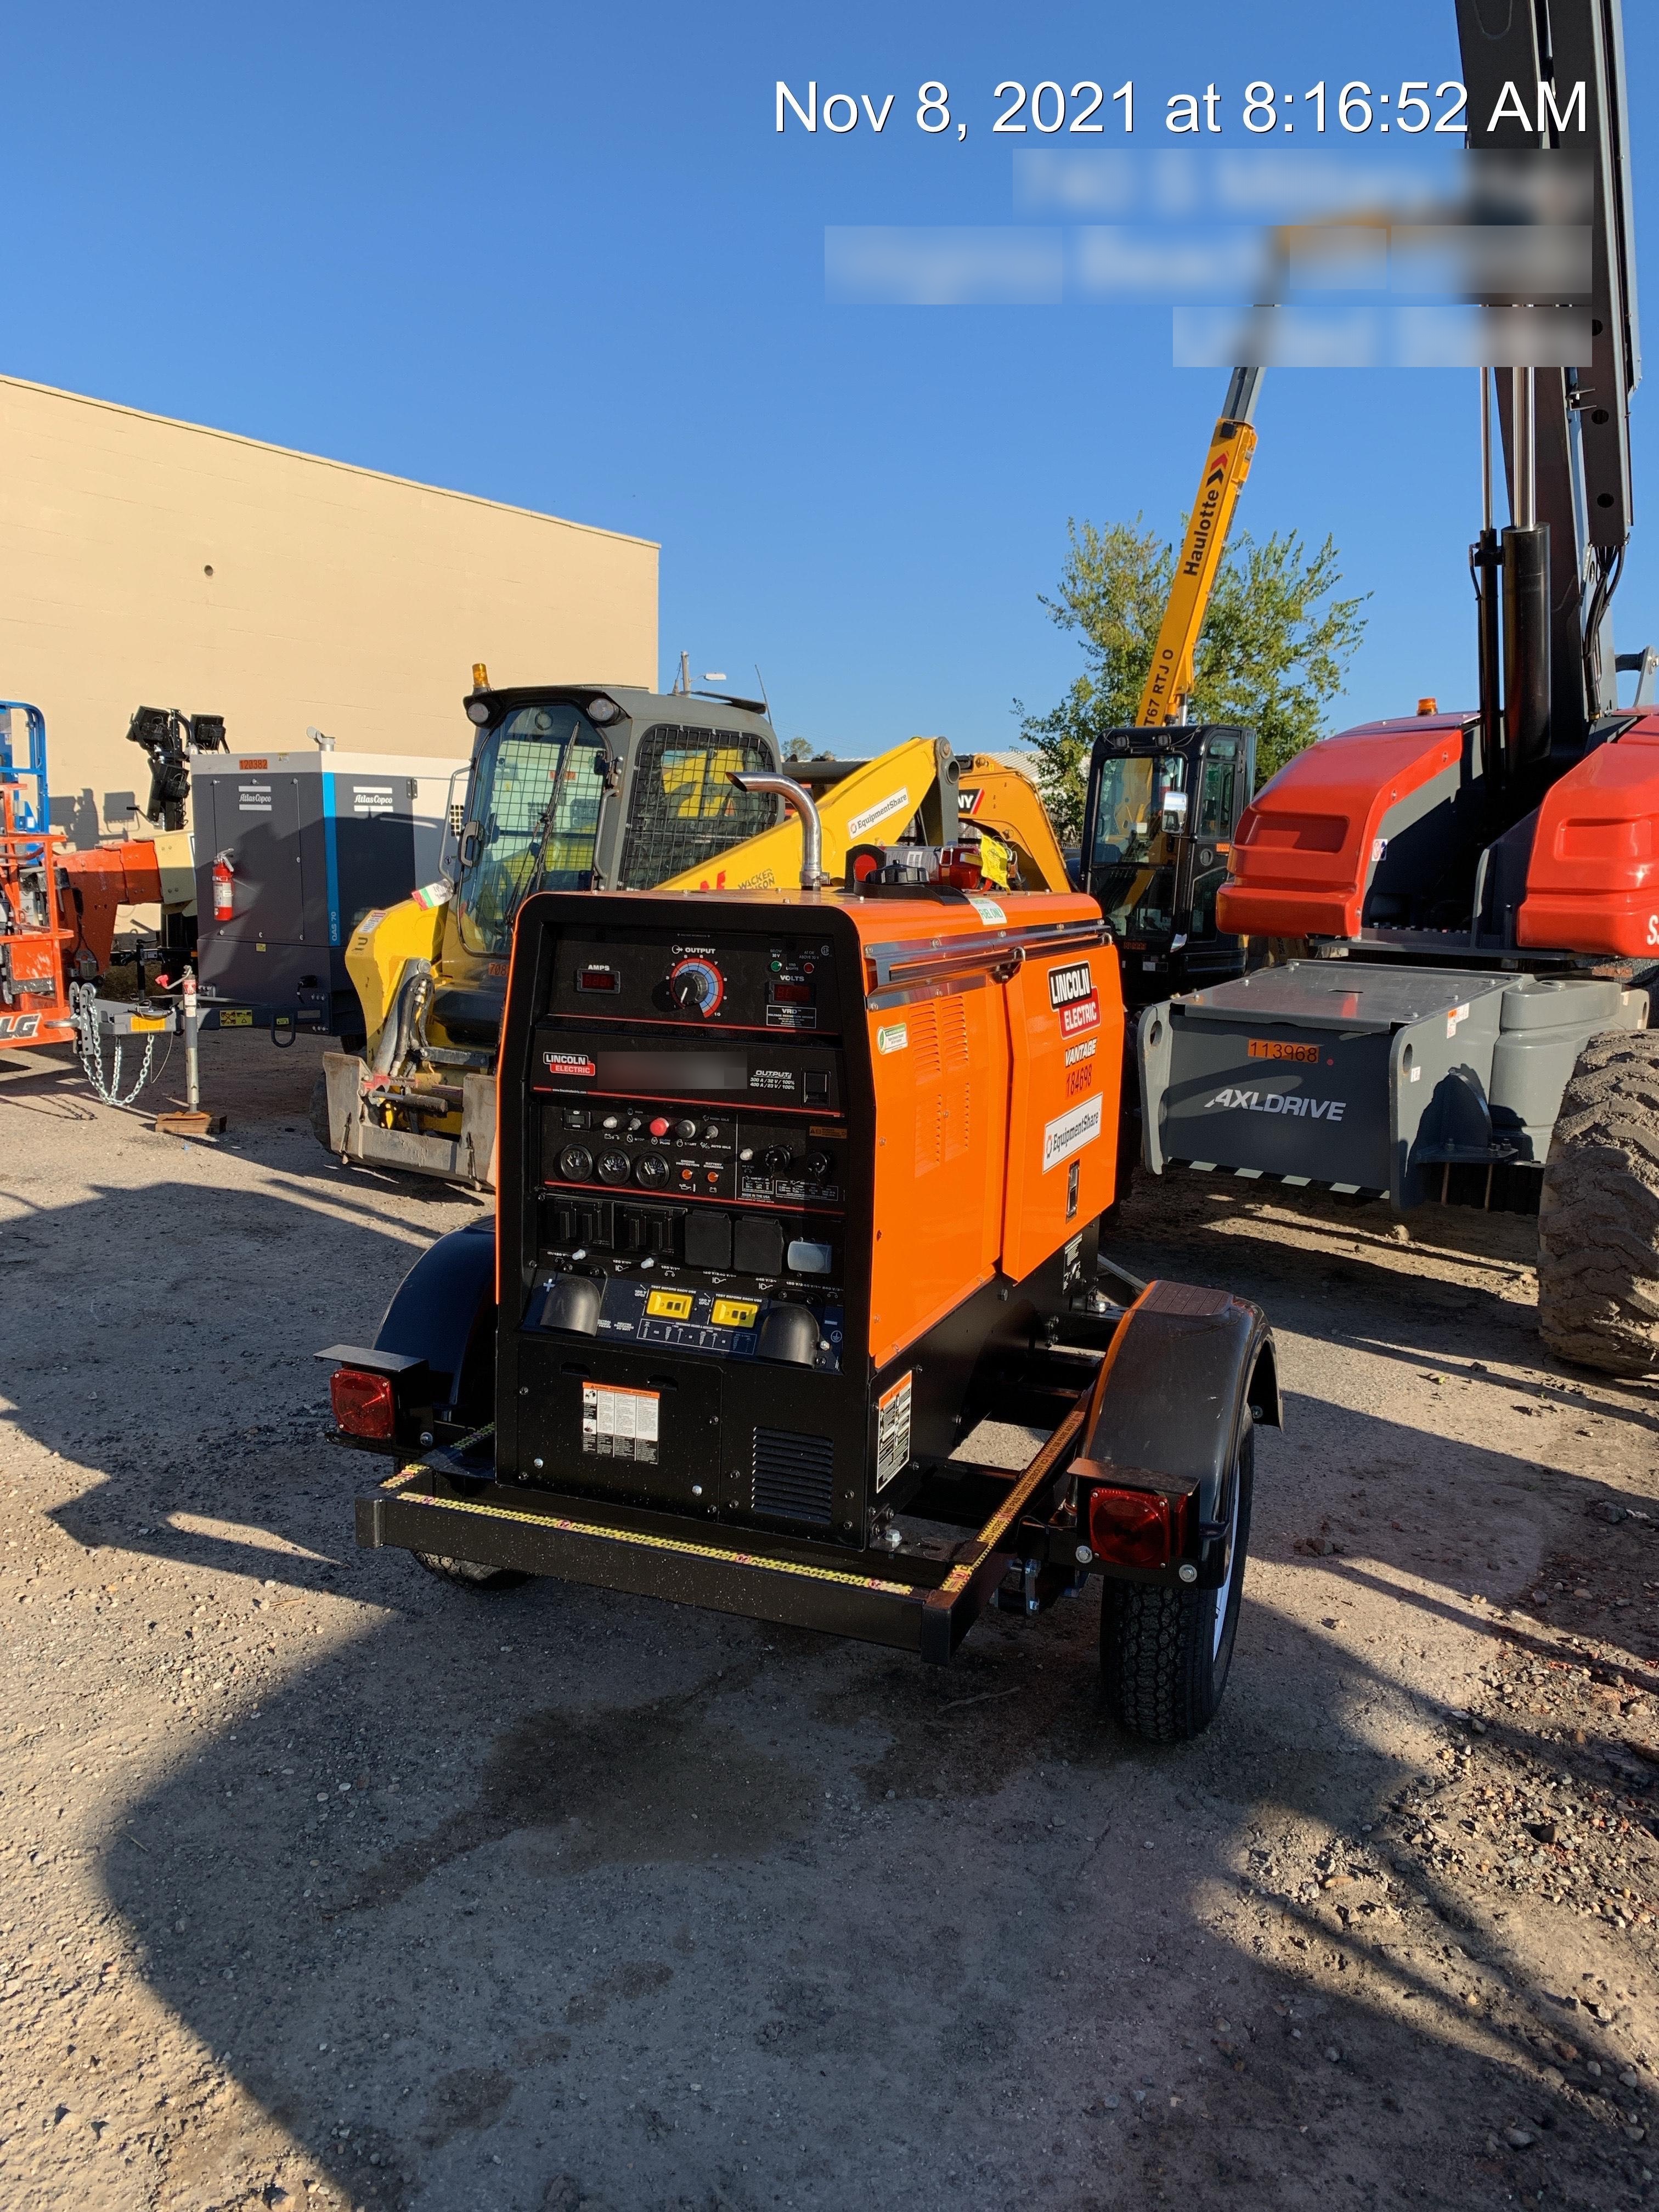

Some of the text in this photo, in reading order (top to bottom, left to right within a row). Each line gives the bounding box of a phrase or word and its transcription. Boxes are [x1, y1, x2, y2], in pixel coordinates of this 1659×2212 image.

[1183, 489, 1220, 576] Haulotte
[1153, 665, 1170, 696] RTJ
[239, 793, 272, 804] Atlas Copco
[353, 794, 393, 806] Atlas Copco
[856, 794, 908, 830] EquipmentShare
[331, 911, 337, 922] 70
[978, 907, 1004, 919] FUEL ONLY
[1646, 914, 1659, 946] S
[489, 963, 510, 976] 708
[1050, 968, 1091, 1005] LINCOLN
[1063, 1000, 1097, 1031] ELECTRIC
[545, 1054, 586, 1065] LINCOLN
[1064, 1038, 1098, 1068] VANTAGE
[1250, 1041, 1319, 1063] 113968
[555, 1065, 591, 1074] ELECTRIC
[755, 1070, 791, 1079] OUTPUT
[1066, 1064, 1092, 1097] 184698
[1204, 1088, 1347, 1122] AXLDRIVE
[1052, 1110, 1099, 1152] EquipmentShare
[1009, 1497, 1022, 1506] PAS
[1016, 1482, 1032, 1497] TENEZ
[1026, 1464, 1045, 1482] DEBOUT
[457, 1503, 478, 1511] NOT
[484, 1507, 521, 1519] STAND
[522, 1515, 557, 1525] HERE
[989, 1519, 1006, 1534] HERE
[590, 1527, 616, 1536] PAS
[619, 1533, 658, 1544] TENEZ
[659, 1541, 713, 1556] DEBOUT
[751, 1558, 773, 1566] NO
[794, 1567, 830, 1579] PARE
[833, 1574, 866, 1584] AQUI
